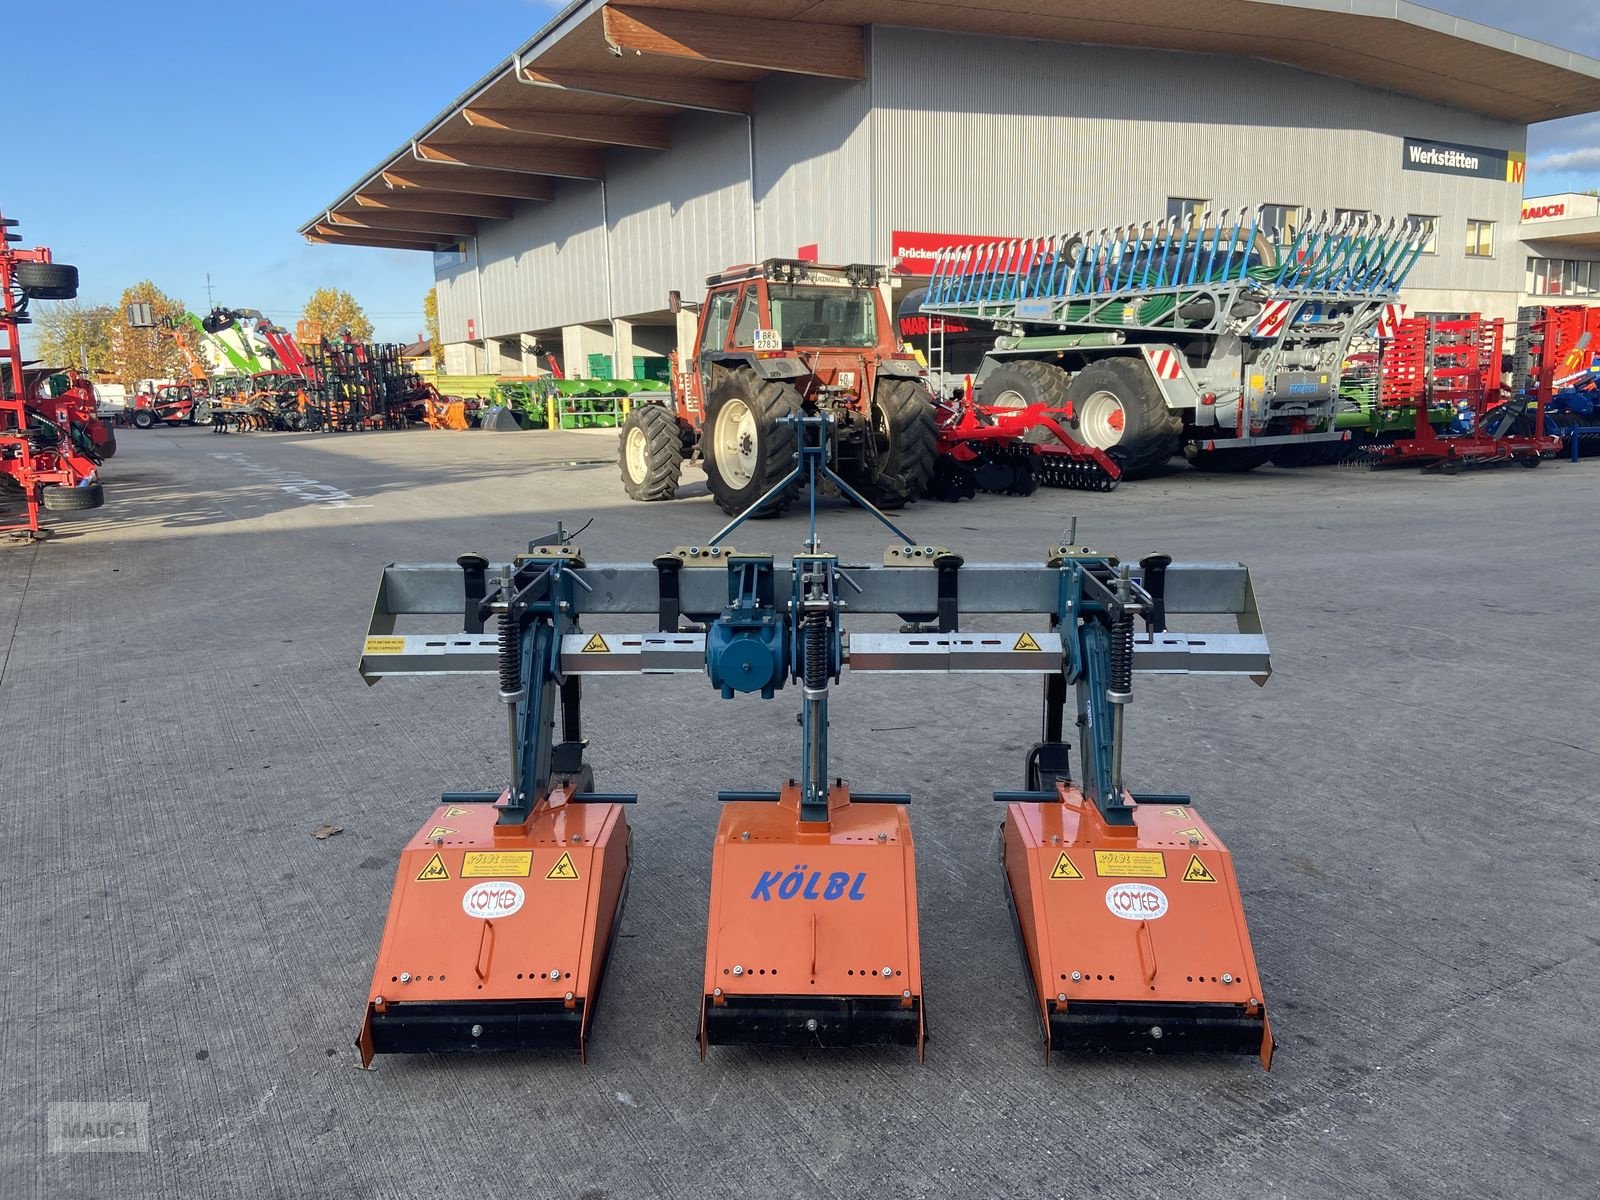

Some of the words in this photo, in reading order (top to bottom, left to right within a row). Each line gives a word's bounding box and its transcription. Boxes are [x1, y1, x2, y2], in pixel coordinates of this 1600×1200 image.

[1409, 145, 1479, 170] Werkstätten
[751, 864, 867, 902] KÖLBL
[470, 888, 517, 910] COMEB
[1113, 890, 1160, 912] COMEB
